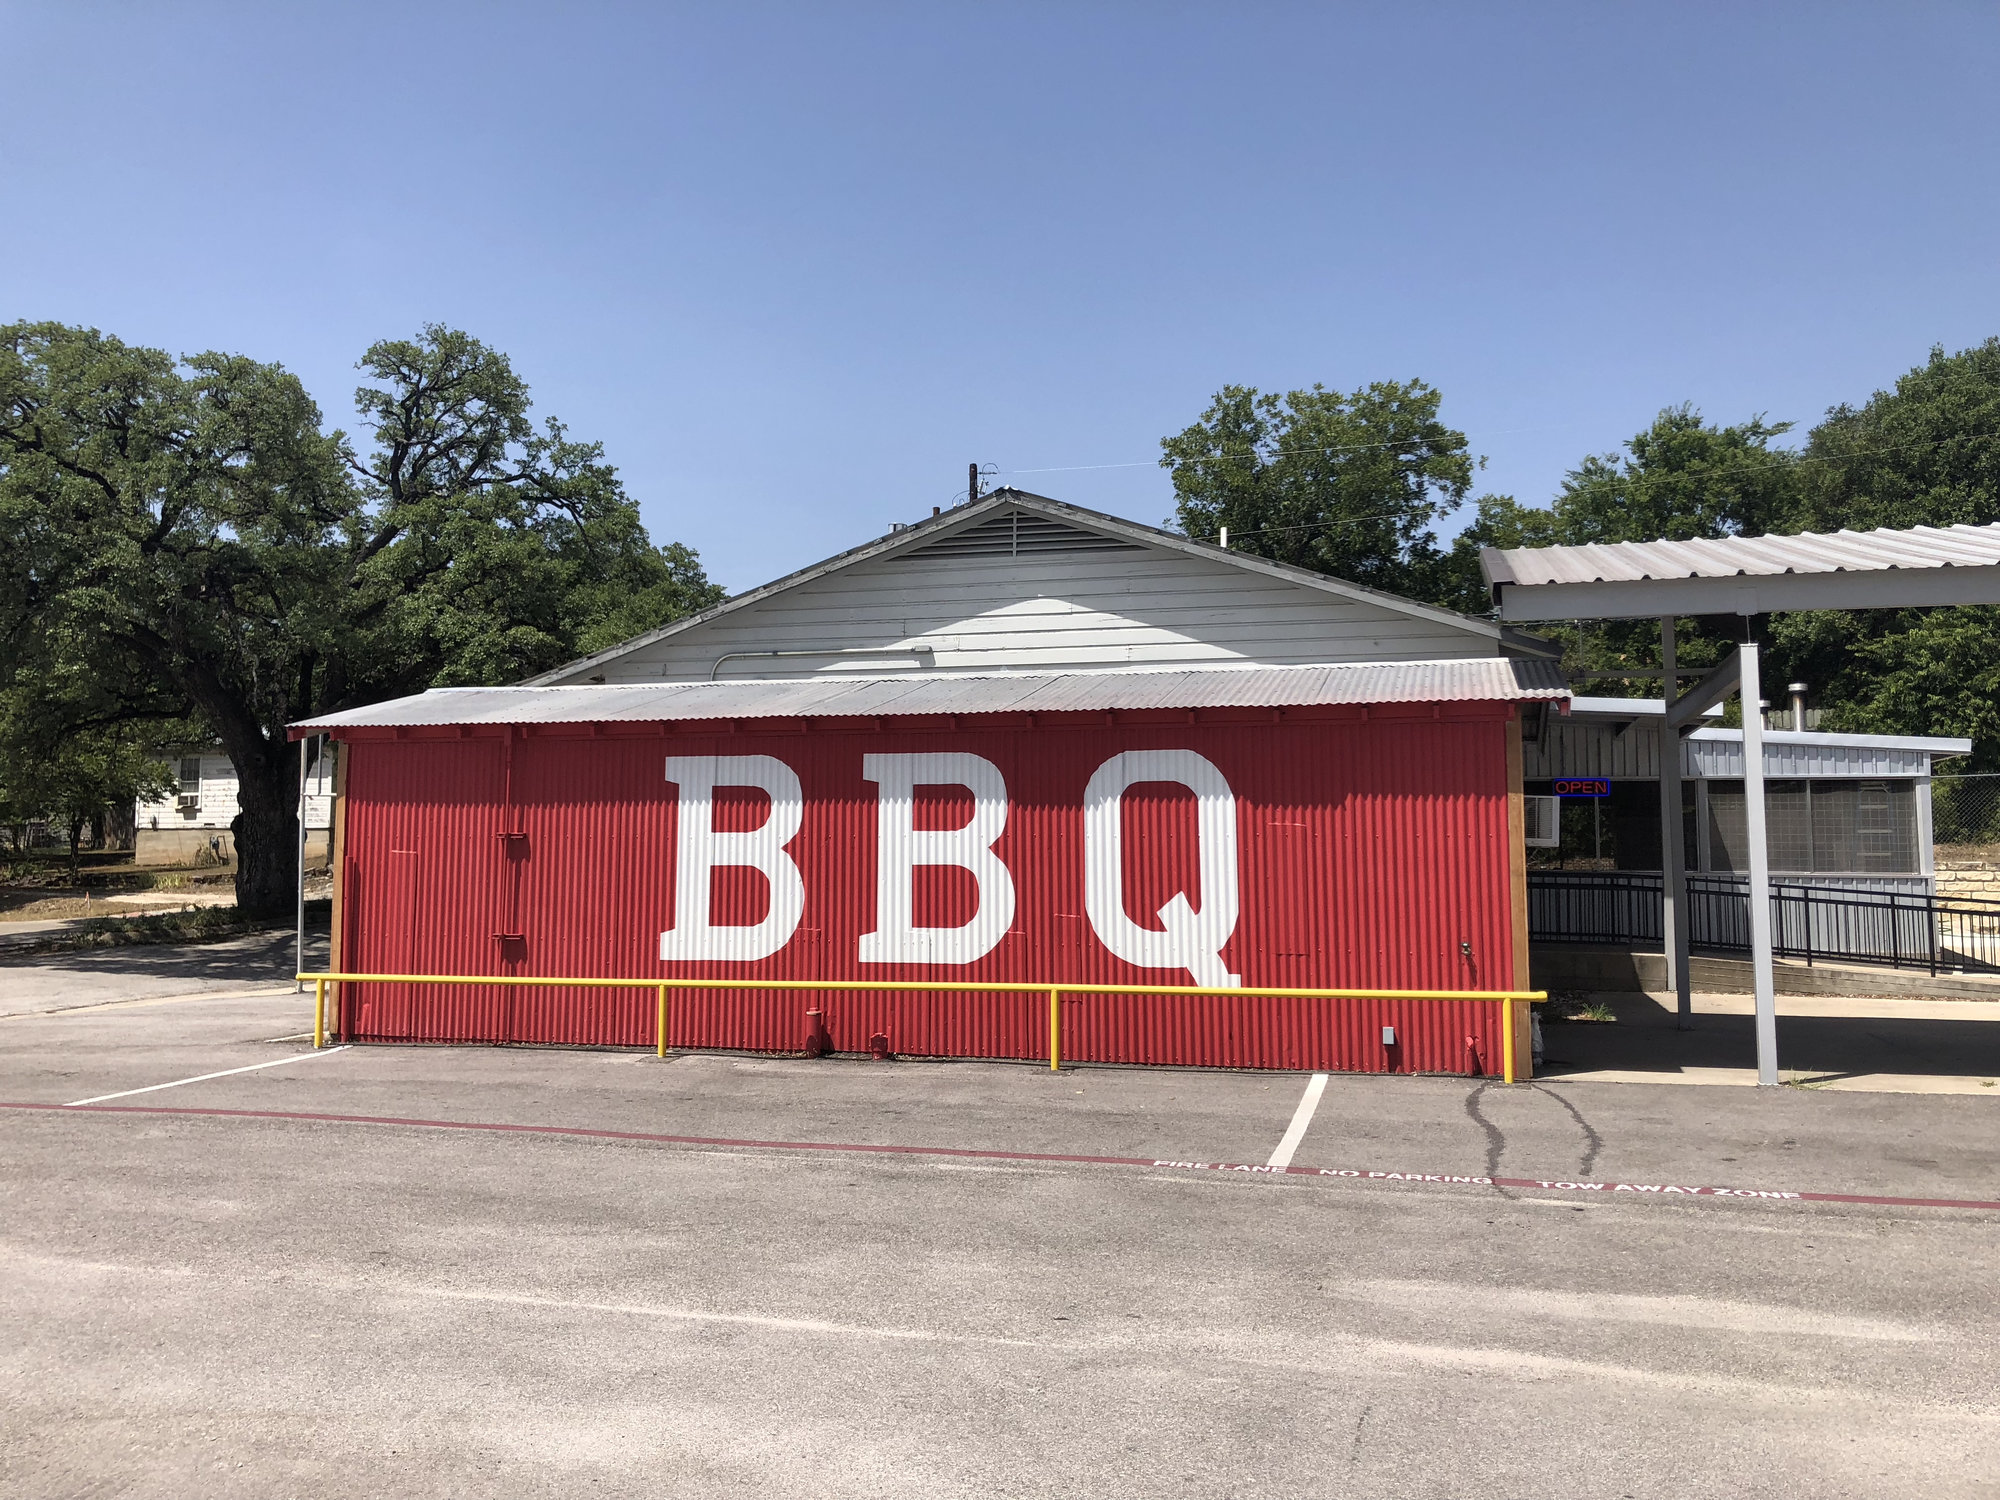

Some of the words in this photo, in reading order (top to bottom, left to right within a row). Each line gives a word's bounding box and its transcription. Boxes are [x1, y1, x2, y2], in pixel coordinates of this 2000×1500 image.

[1555, 781, 1607, 793] OPEN
[660, 749, 1241, 988] BBQ
[1153, 1160, 1211, 1170] FIRE
[1218, 1164, 1288, 1173] LANE
[1319, 1169, 1360, 1178] NO
[1369, 1171, 1493, 1184] PARKING
[1536, 1180, 1604, 1191] TOW
[1614, 1184, 1702, 1194] AWAY
[1712, 1187, 1803, 1199] ZONE
